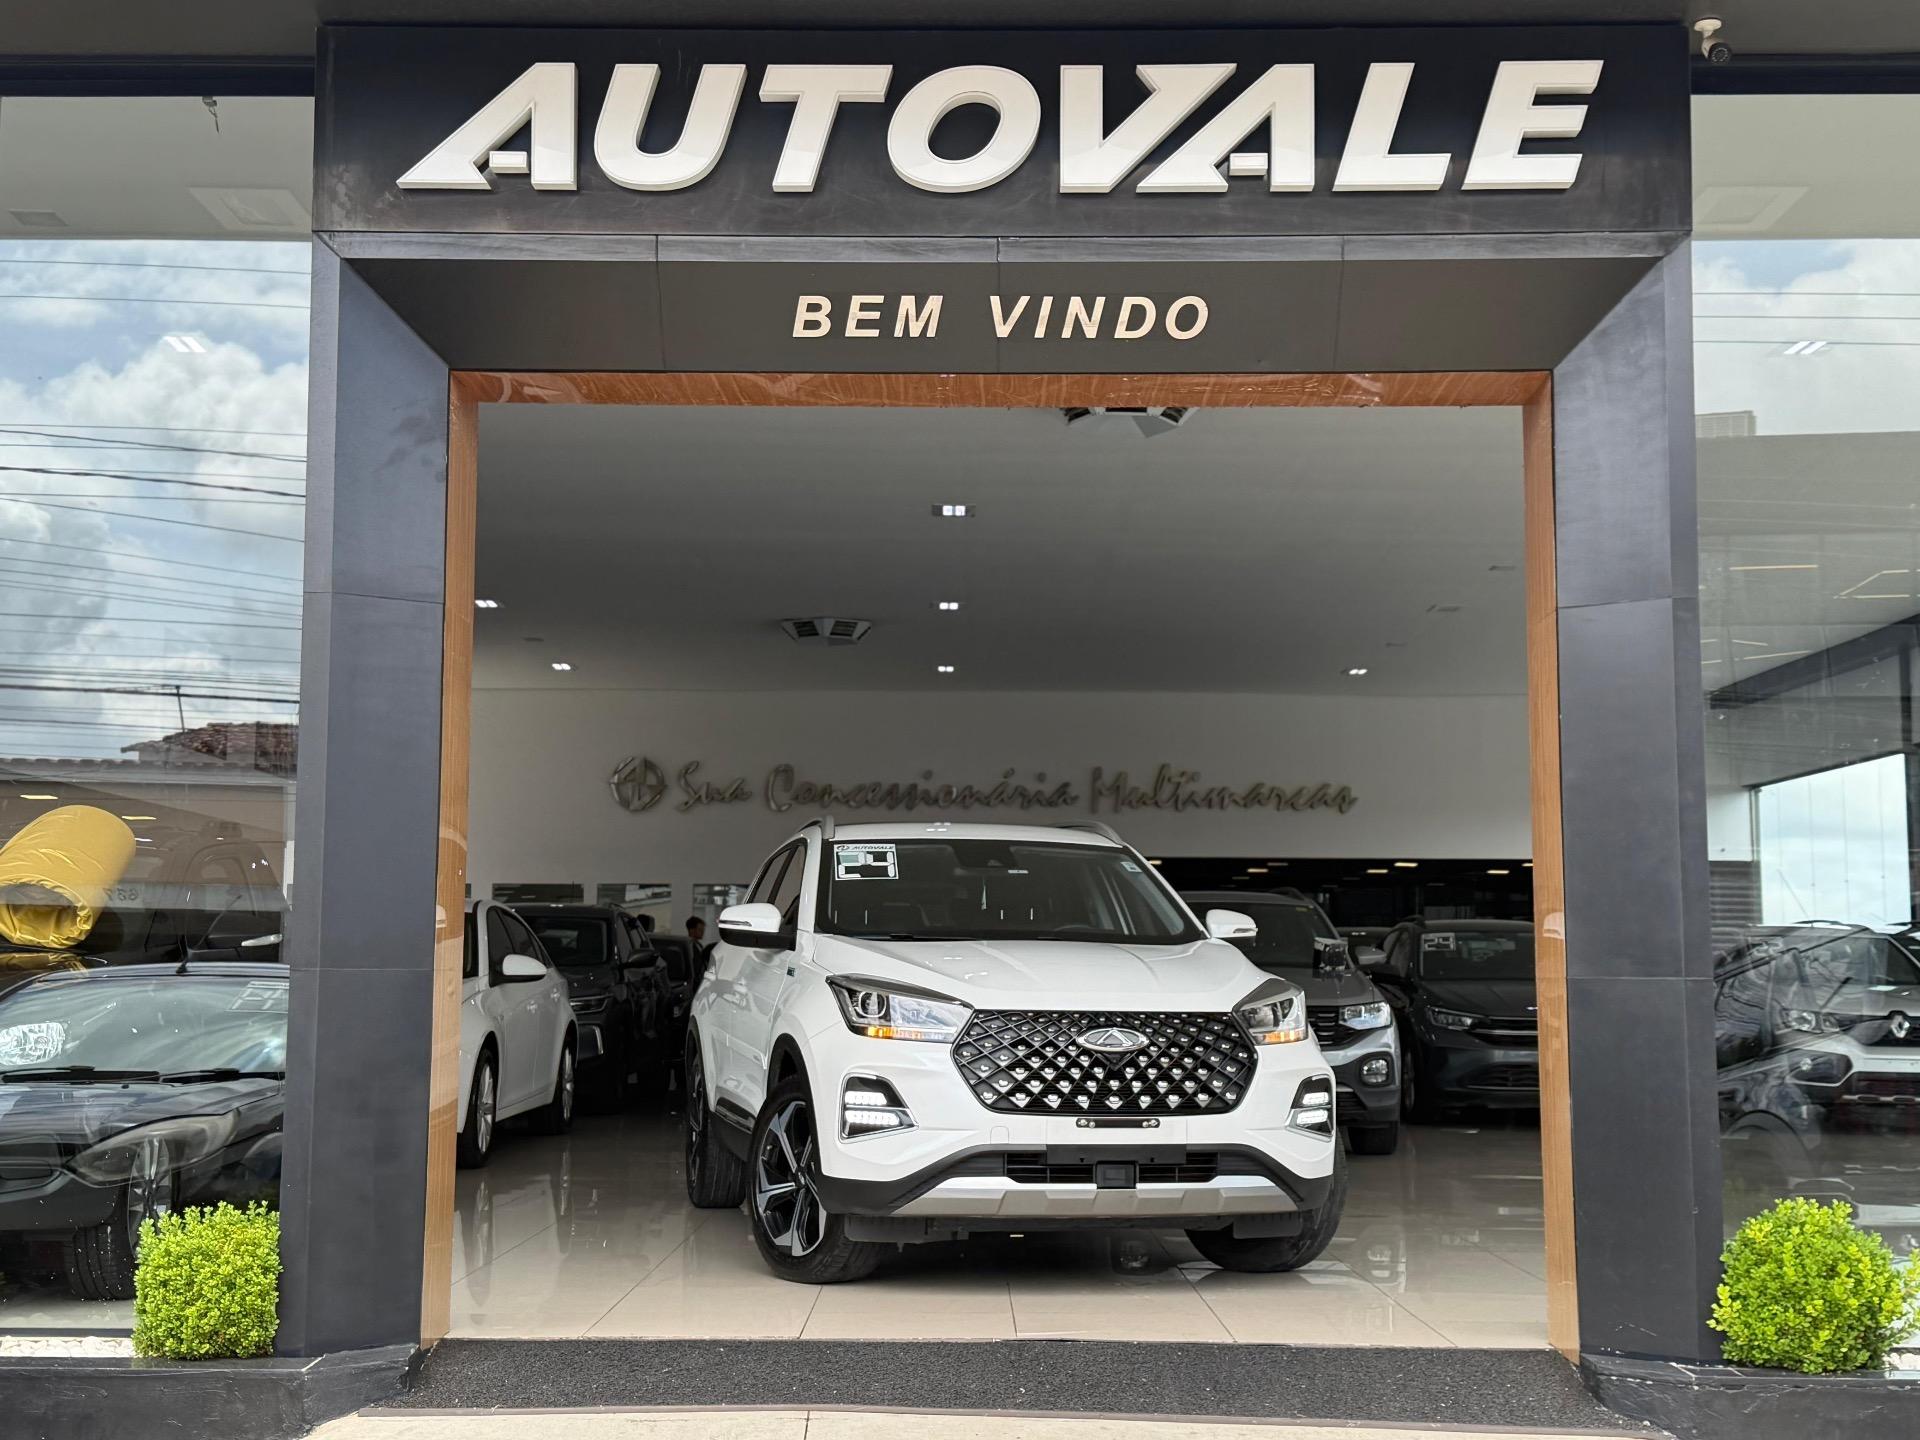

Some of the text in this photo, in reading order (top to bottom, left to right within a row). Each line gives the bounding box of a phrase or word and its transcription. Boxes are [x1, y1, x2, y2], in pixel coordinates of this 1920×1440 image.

[396, 60, 1605, 194] AUTOVALE
[792, 295, 1209, 340] BEM VINDO
[676, 761, 1359, 814] Sua Concessionária Multimarcas
